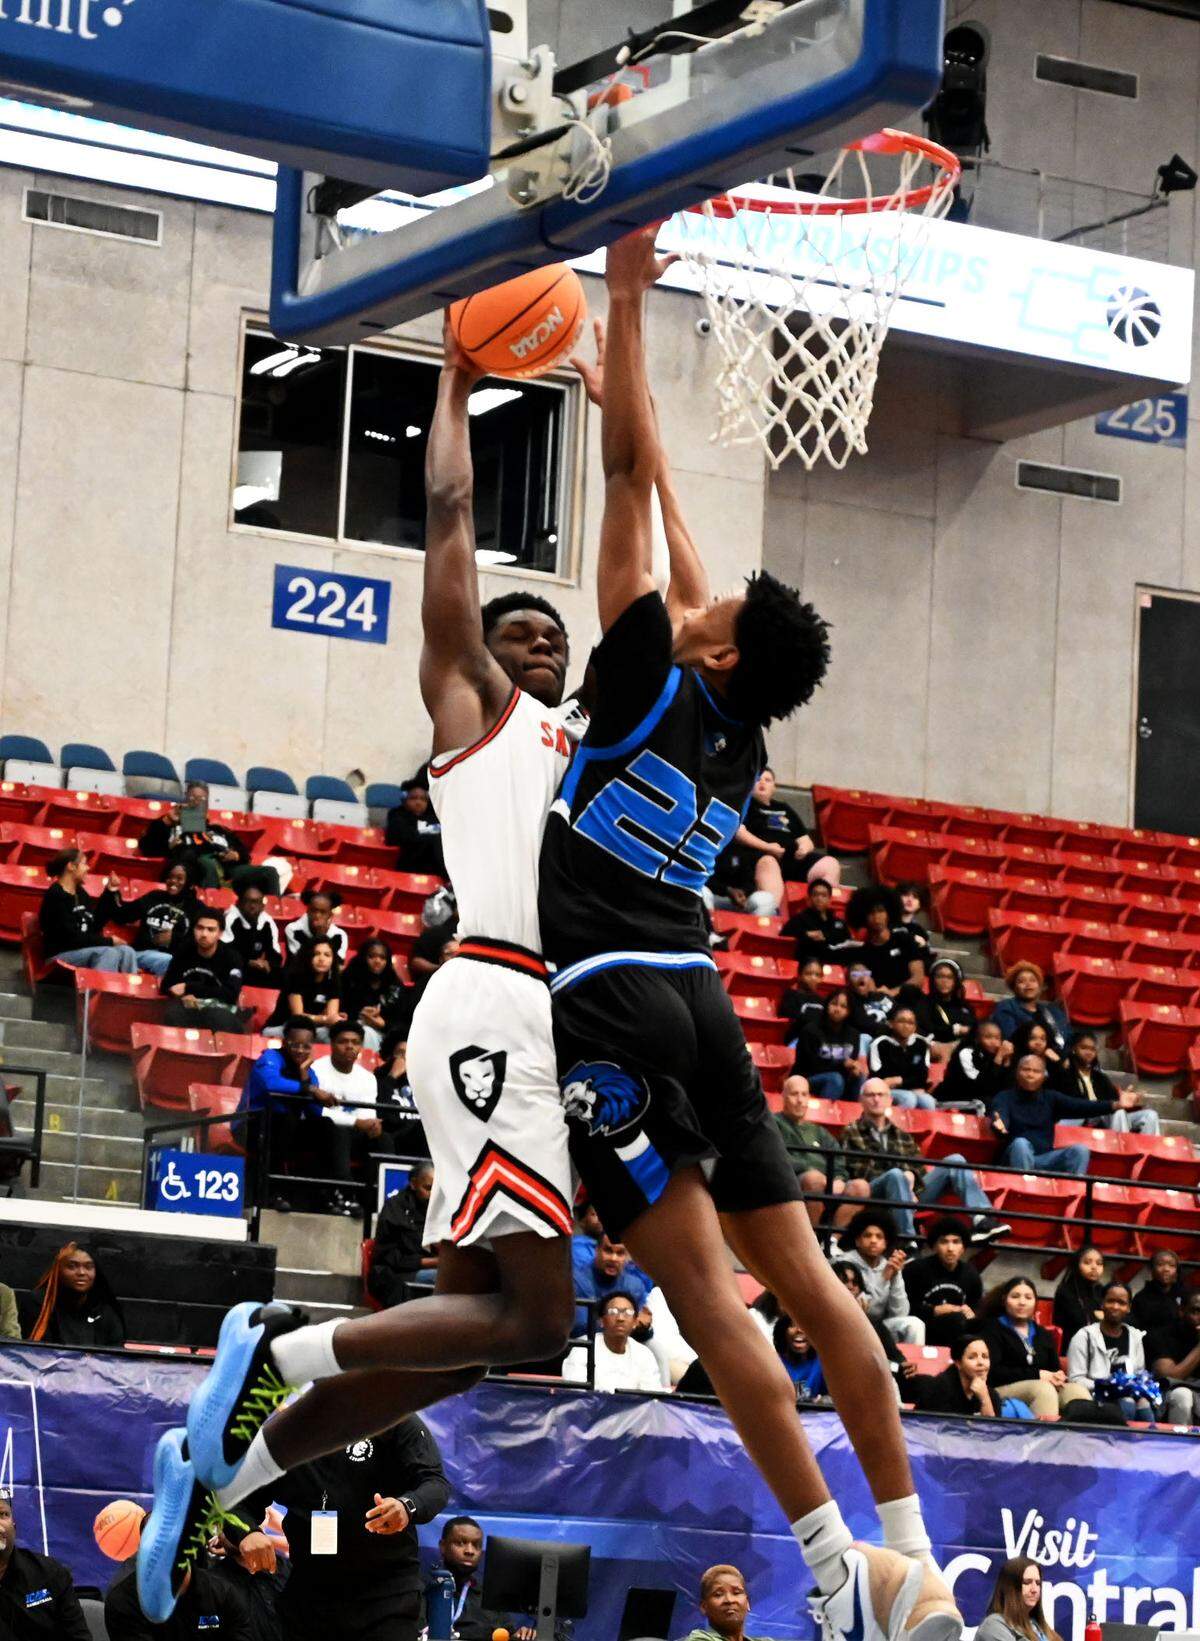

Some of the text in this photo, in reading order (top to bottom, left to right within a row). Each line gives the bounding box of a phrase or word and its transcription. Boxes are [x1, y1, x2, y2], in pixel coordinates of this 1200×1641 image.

[509, 305, 564, 358] NCAA
[1107, 398, 1176, 437] 225
[285, 577, 377, 632] 224
[572, 749, 740, 897] 23
[195, 1170, 239, 1201] 123
[1001, 1507, 1098, 1568] Visit
[942, 1552, 1200, 1641] Cntra
